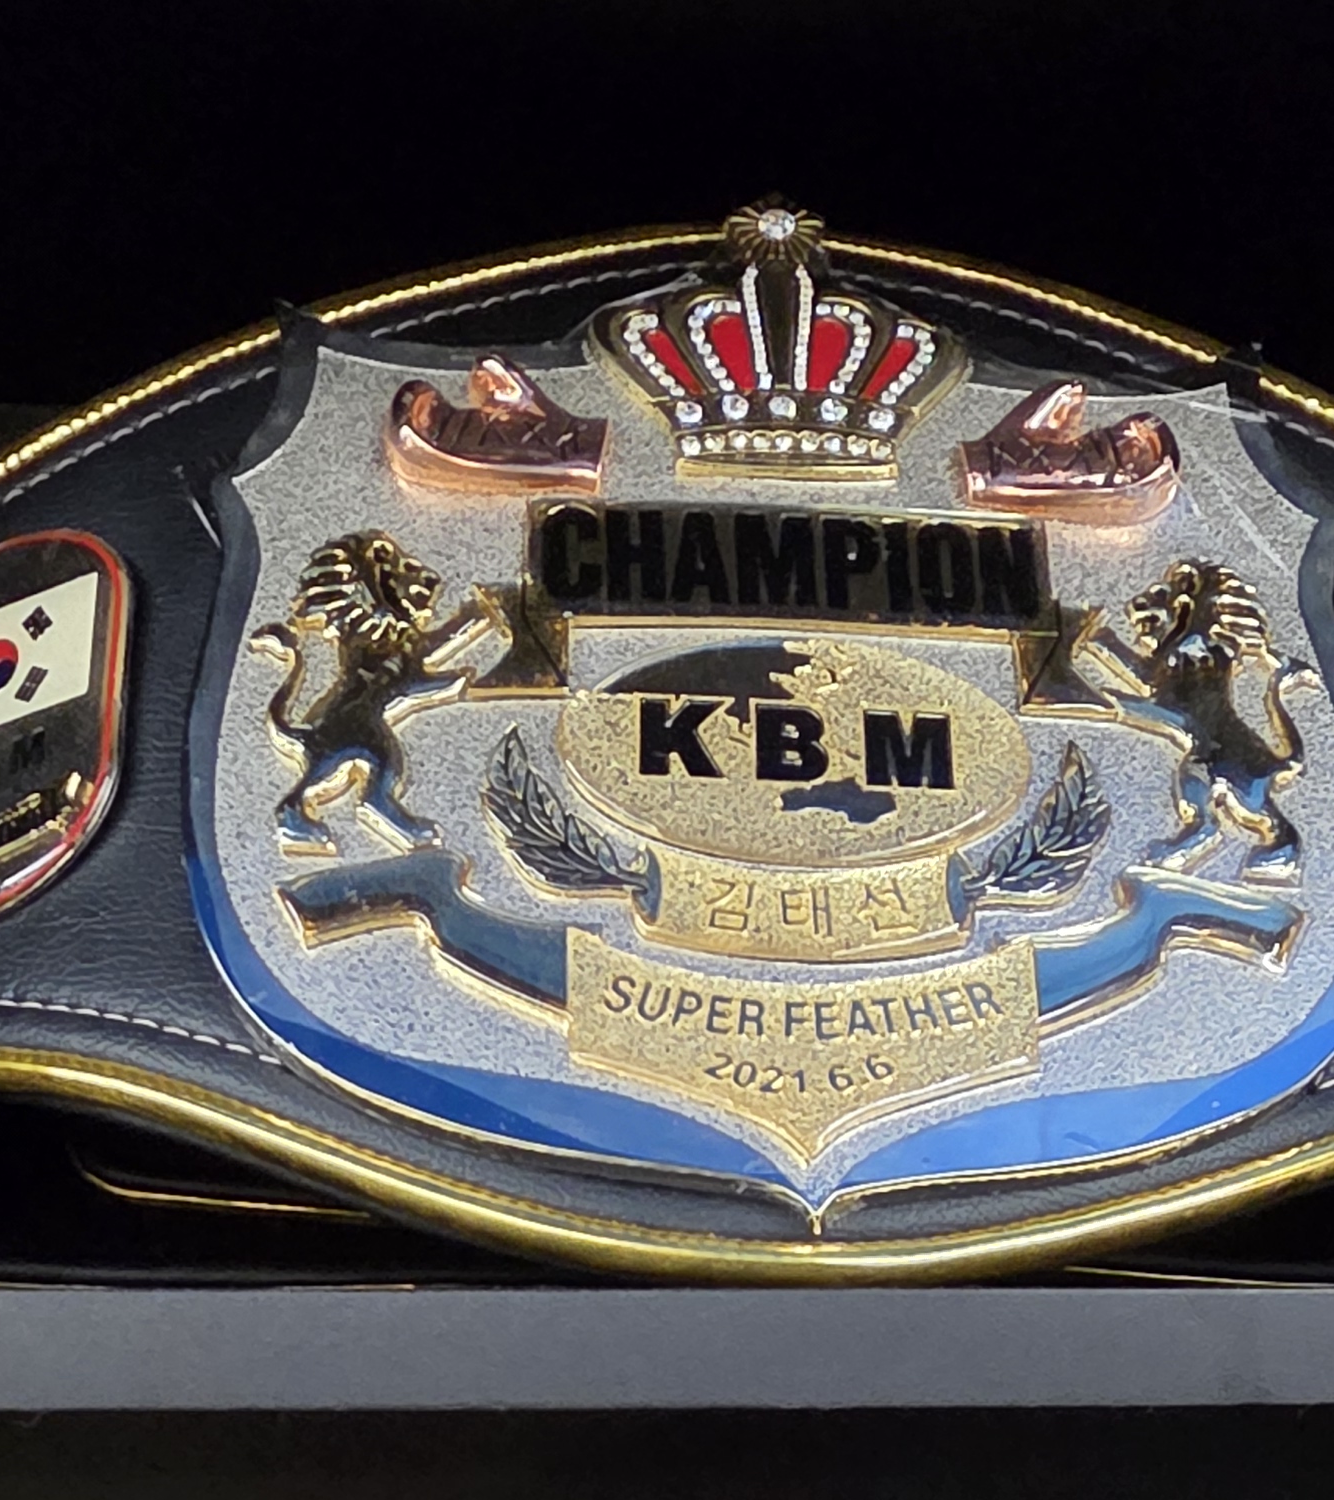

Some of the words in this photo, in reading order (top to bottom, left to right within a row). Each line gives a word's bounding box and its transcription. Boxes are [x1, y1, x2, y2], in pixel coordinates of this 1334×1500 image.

[540, 503, 1041, 618] CHAMPION
[603, 974, 765, 1037] SUPER
[783, 981, 1005, 1041] FEATHER
